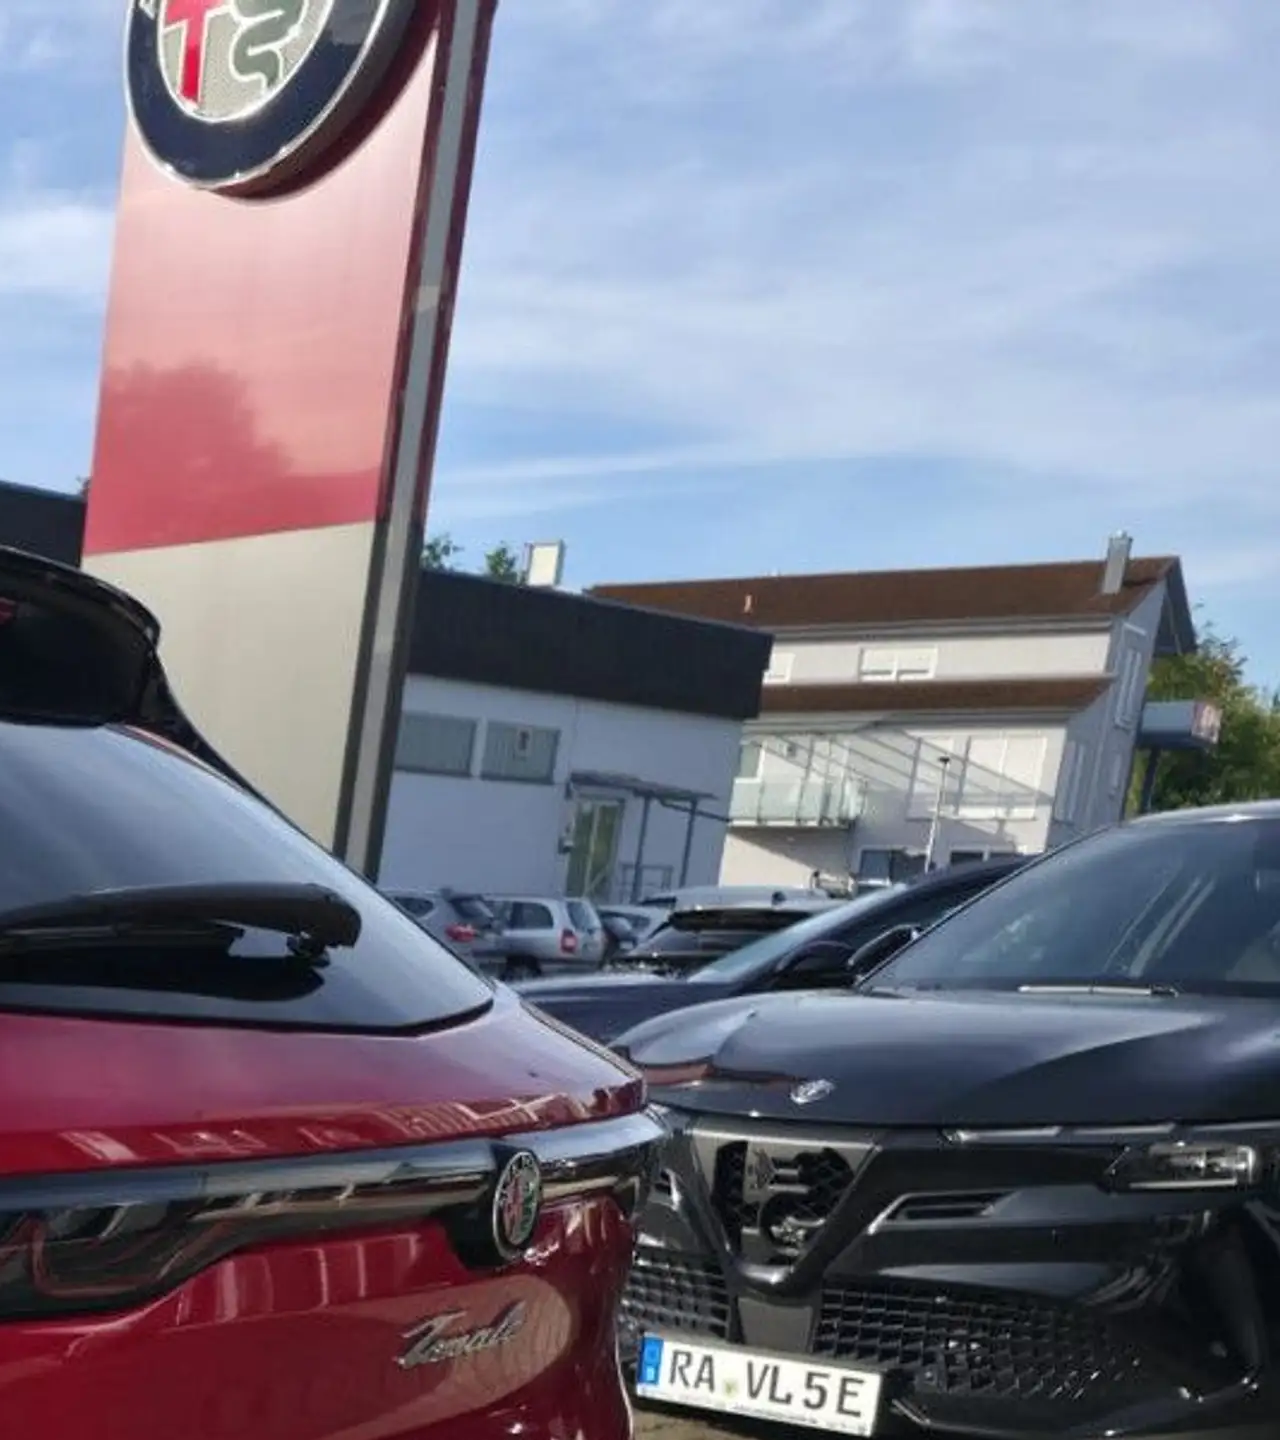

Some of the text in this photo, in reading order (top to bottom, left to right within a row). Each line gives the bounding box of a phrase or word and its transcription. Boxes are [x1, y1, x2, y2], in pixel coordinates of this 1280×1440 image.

[668, 1350, 716, 1394] RA
[747, 1360, 792, 1405] VL
[803, 1371, 865, 1418] 5E
